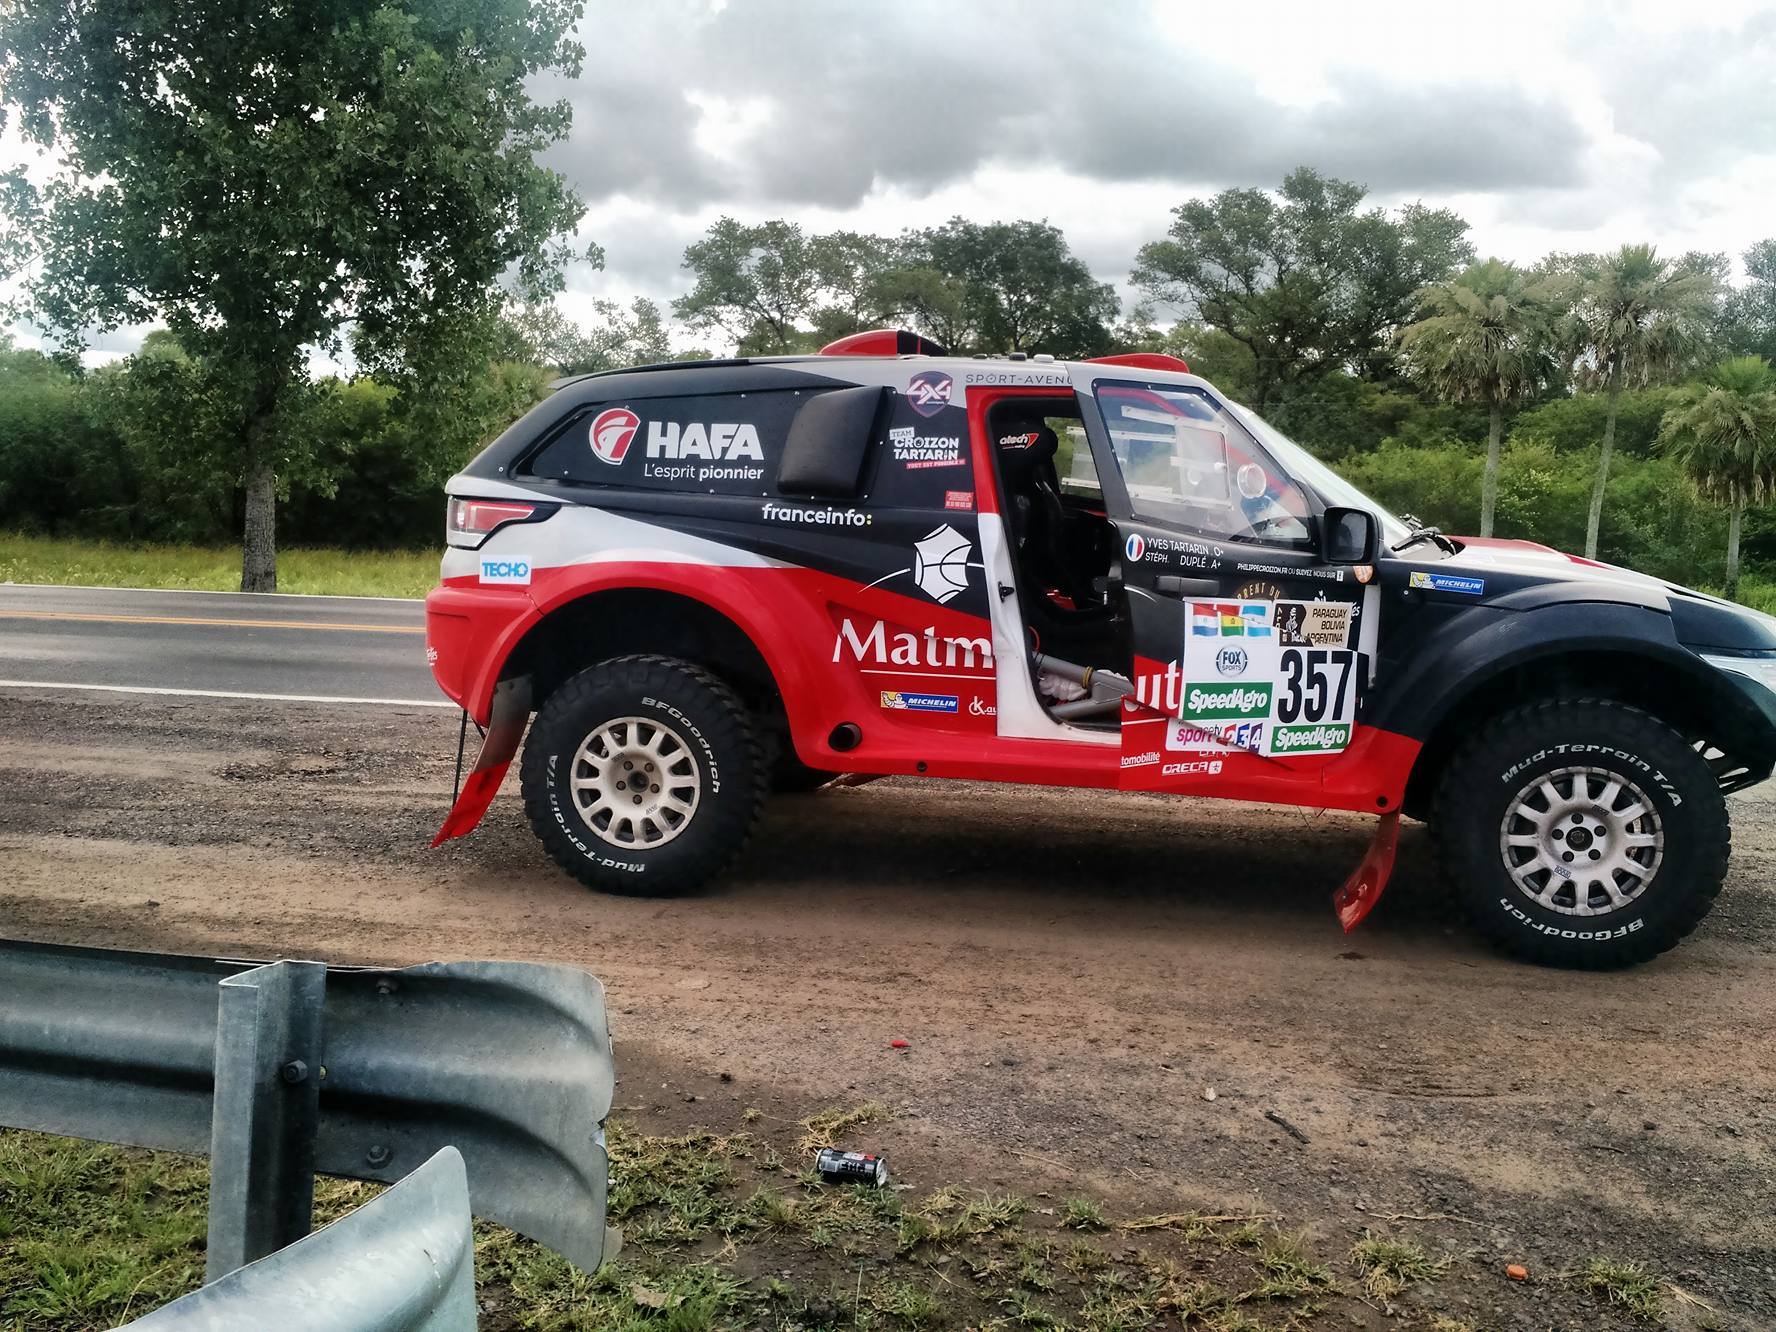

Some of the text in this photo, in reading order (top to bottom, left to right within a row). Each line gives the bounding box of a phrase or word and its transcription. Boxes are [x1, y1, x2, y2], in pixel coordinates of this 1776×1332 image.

[646, 421, 764, 460] HAFA
[894, 437, 959, 449] CROIZON
[893, 448, 959, 461] TARTARIN
[644, 463, 764, 481] L'esprit pionnier
[1147, 537, 1168, 550] YVES
[1169, 540, 1209, 554] TARTARIN
[481, 561, 529, 577] TECHO
[1436, 579, 1482, 590] MICHELIN
[1312, 608, 1348, 618] PARAGUAY
[1321, 620, 1345, 630] BOLIVIA
[1222, 650, 1242, 665] FOX
[1277, 649, 1353, 724] 357
[908, 697, 957, 708] MICHELIN
[1188, 689, 1267, 713] SpeedAgro
[641, 696, 721, 794] BFGoodrich
[1275, 727, 1346, 751] SpeedAgro
[1163, 761, 1208, 775] ORECA
[1501, 743, 1682, 807] Mud-Terrain T/A
[1500, 897, 1644, 941] BFGoodrich
